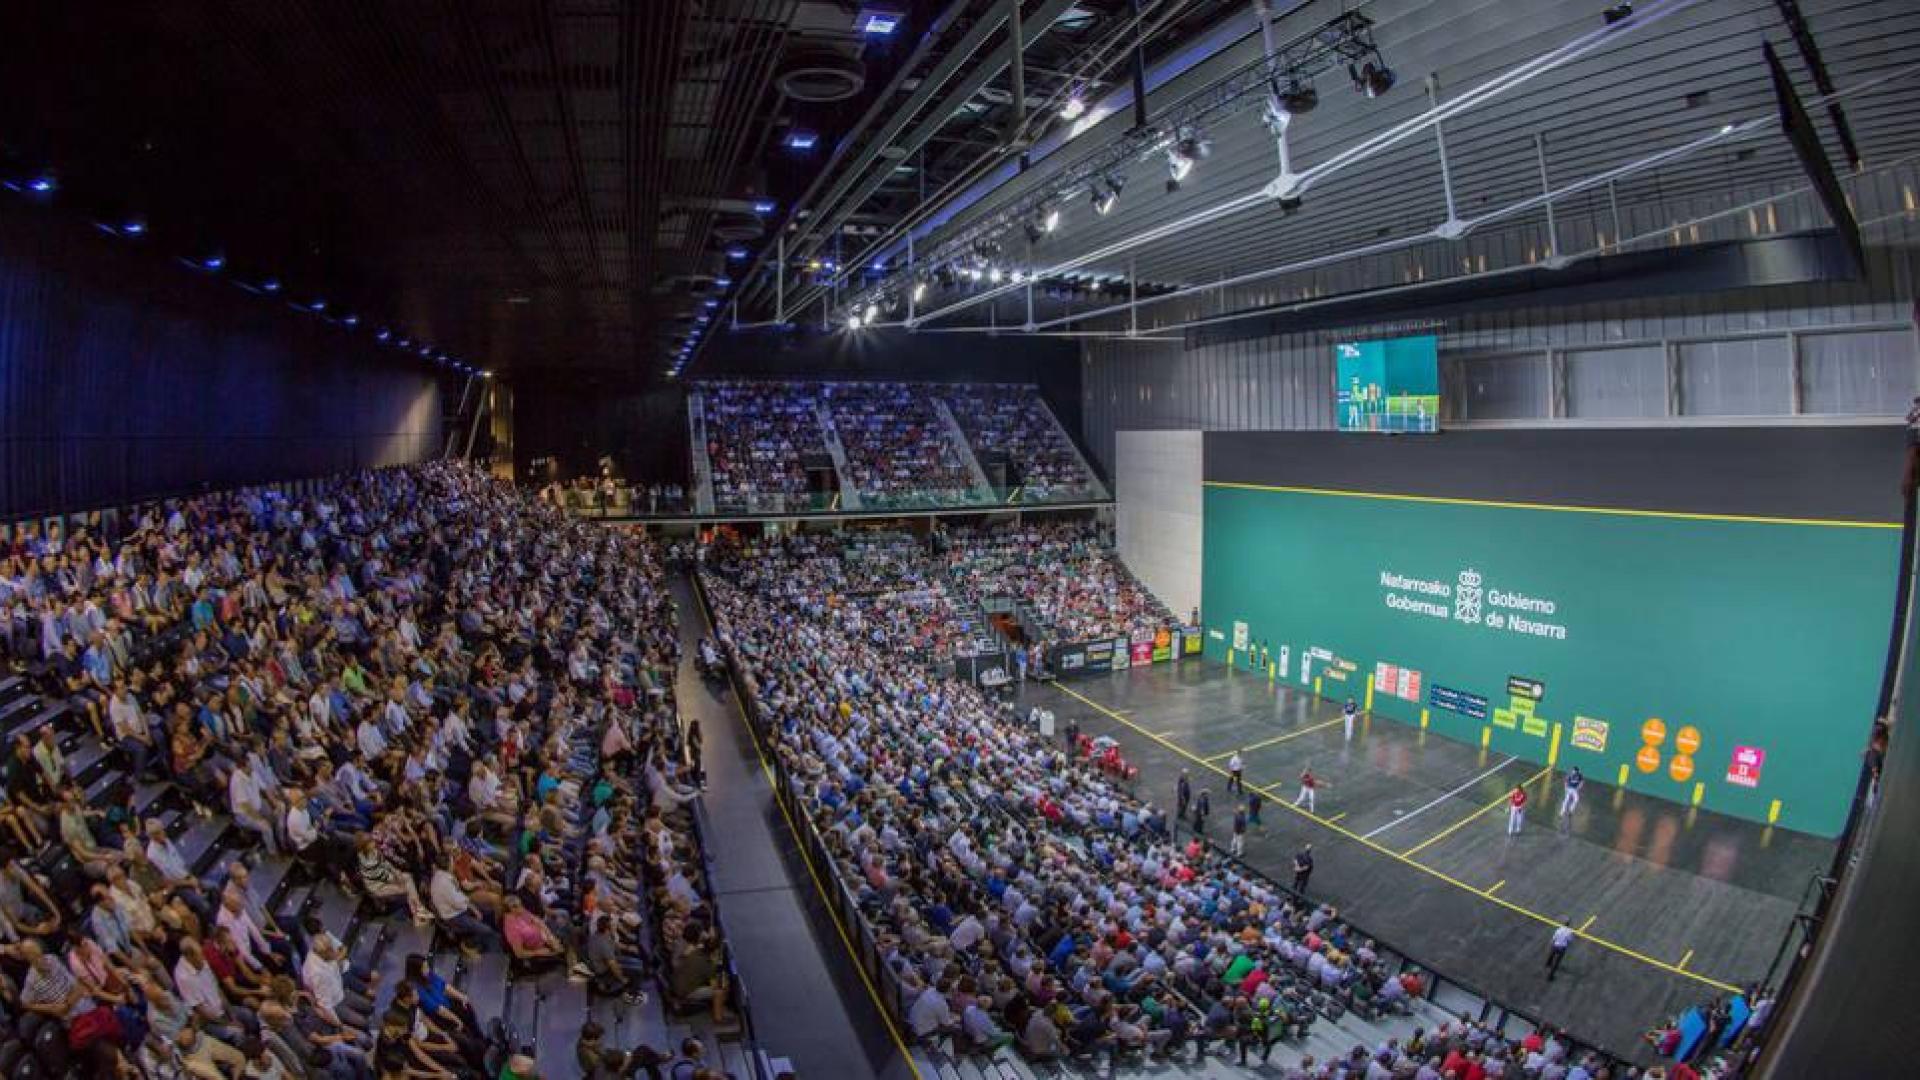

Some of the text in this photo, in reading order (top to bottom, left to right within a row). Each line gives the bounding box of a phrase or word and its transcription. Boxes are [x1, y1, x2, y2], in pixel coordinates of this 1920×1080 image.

[1386, 593, 1448, 618] Gobernua
[1488, 589, 1556, 615] Gobierno
[1486, 612, 1566, 640] de Navarra
